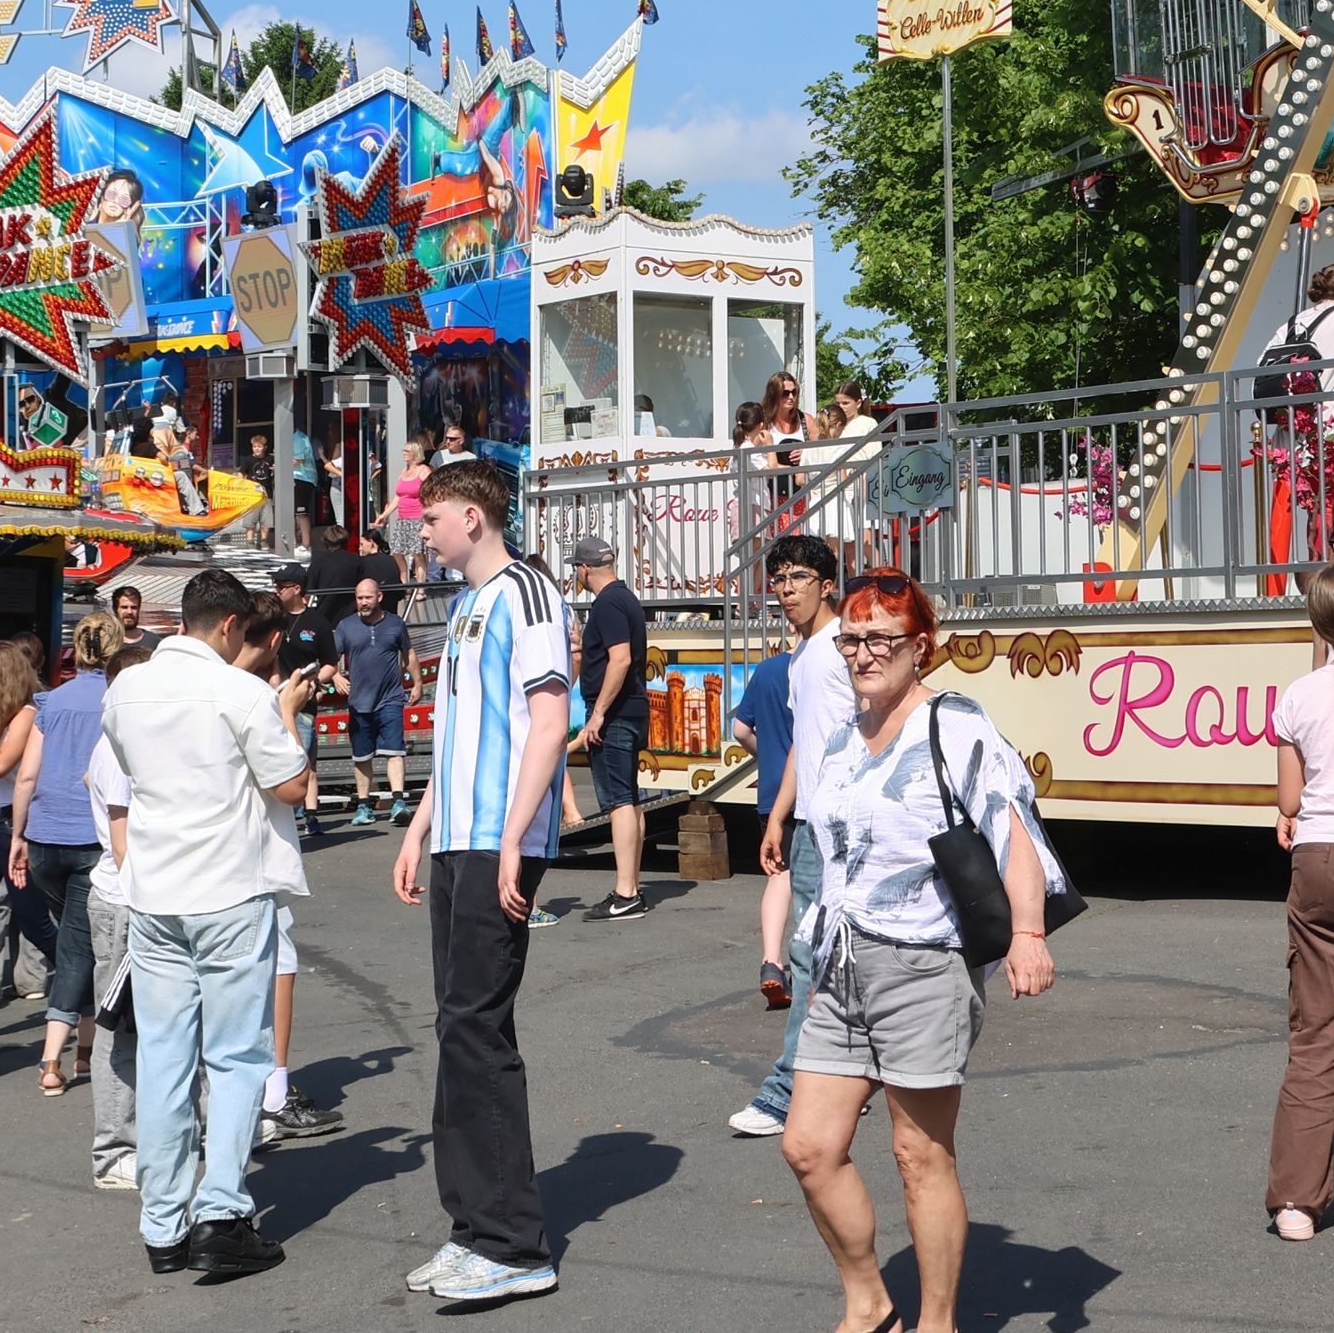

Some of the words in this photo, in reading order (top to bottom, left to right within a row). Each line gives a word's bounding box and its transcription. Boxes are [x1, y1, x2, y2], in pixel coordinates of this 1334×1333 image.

[1152, 109, 1164, 130] 1
[236, 266, 291, 313] STOP
[212, 483, 249, 492] Power
[895, 465, 945, 493] Eingang
[212, 495, 250, 510] Machine
[1083, 649, 1278, 757] Rou
